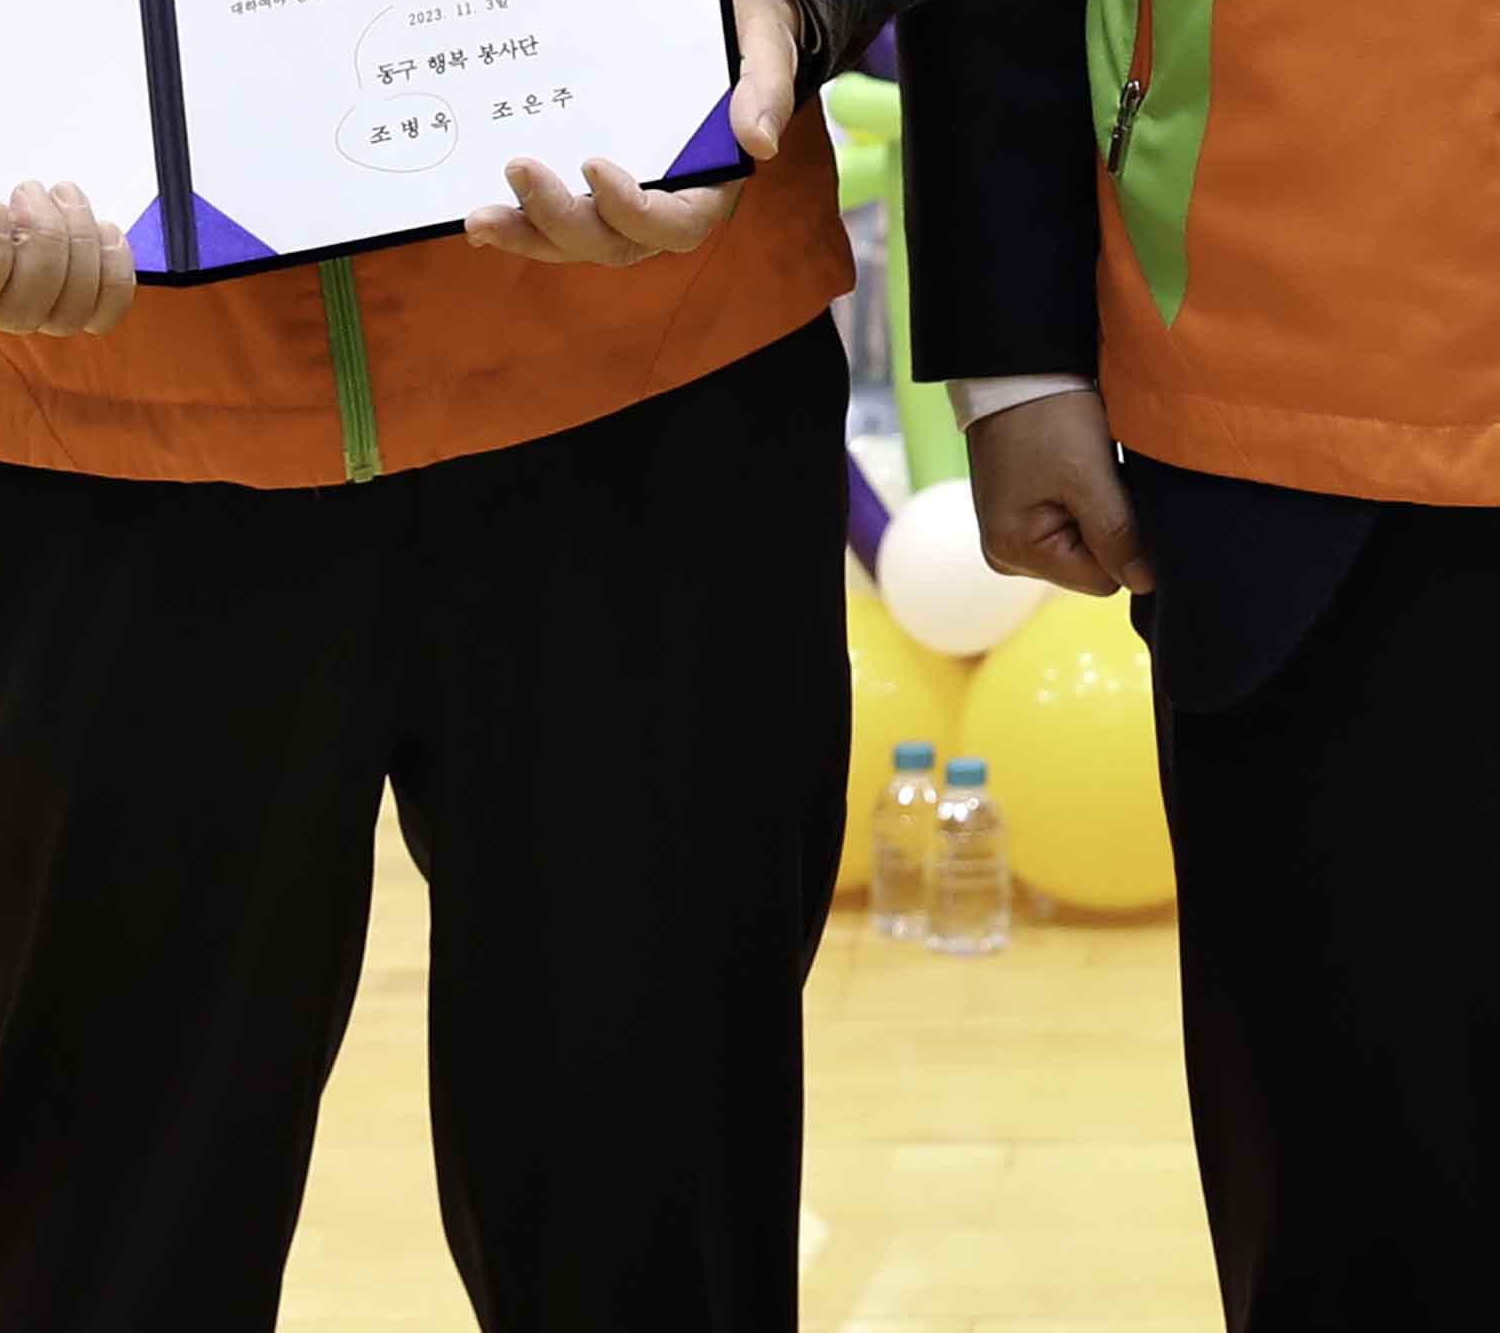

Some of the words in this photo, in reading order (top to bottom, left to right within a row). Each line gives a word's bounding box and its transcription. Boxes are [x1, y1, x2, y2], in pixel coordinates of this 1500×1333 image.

[376, 59, 418, 85] 동구
[427, 48, 468, 75] 행복
[478, 34, 539, 65] 봉사단
